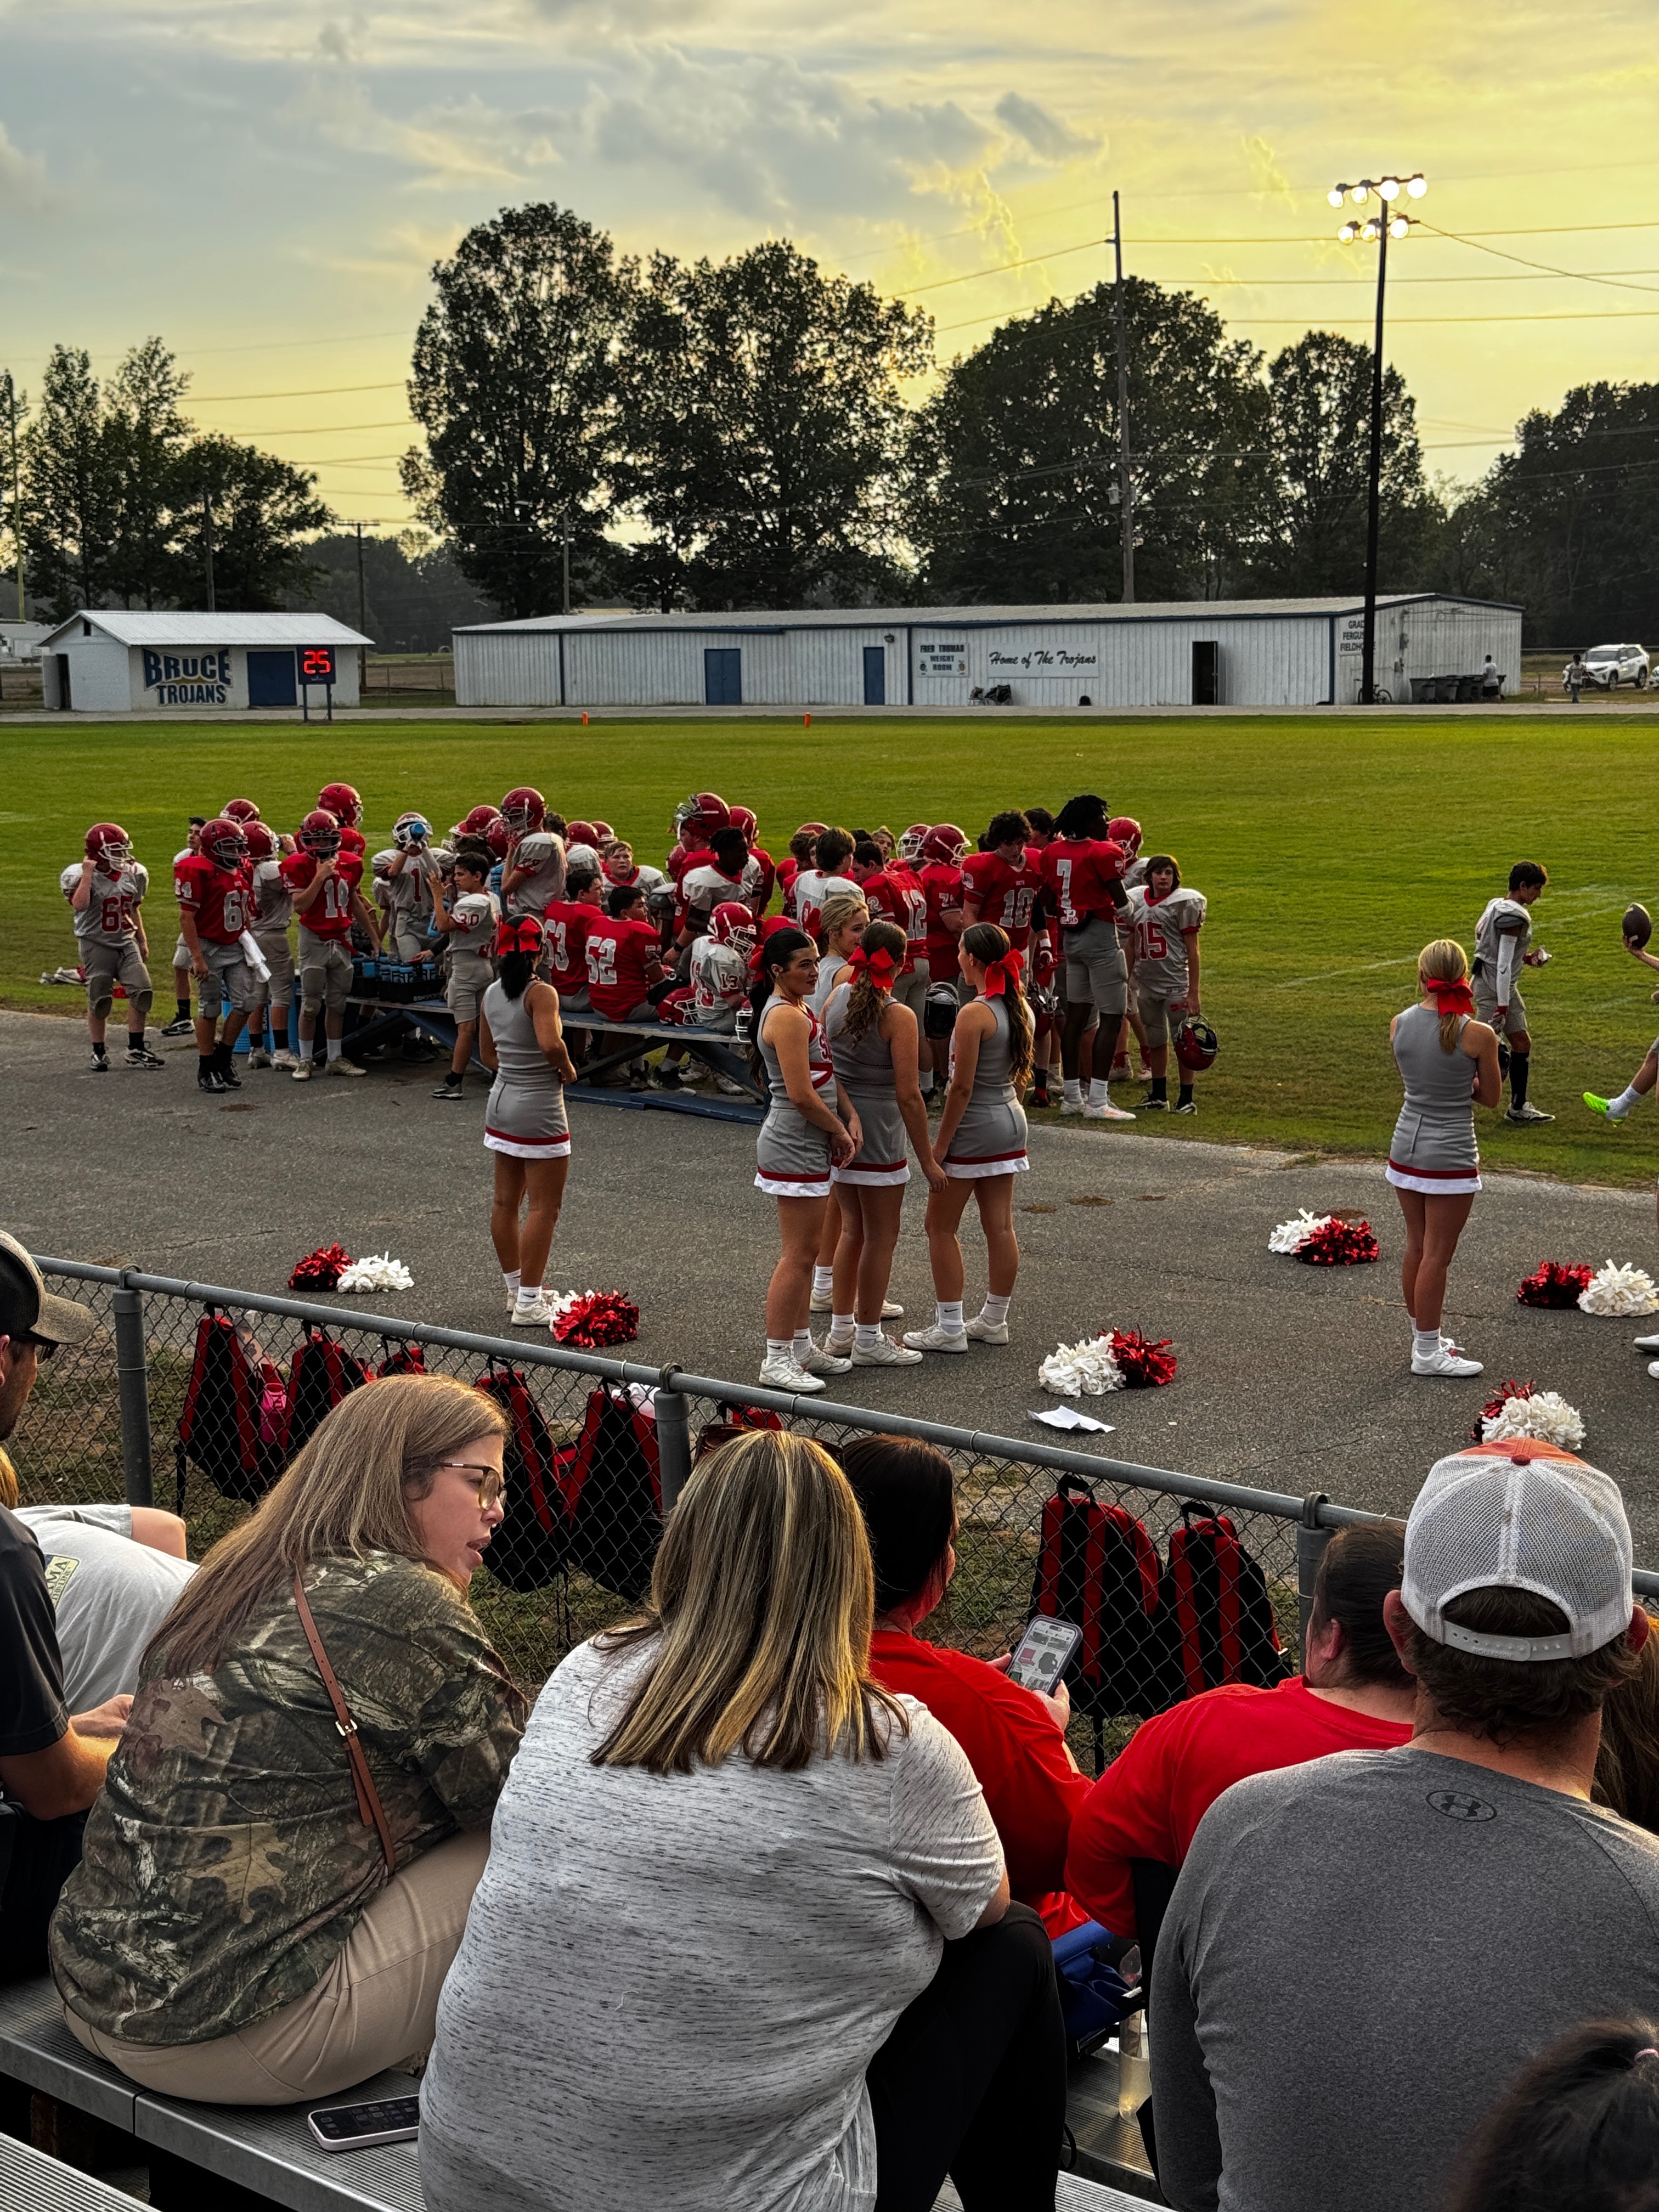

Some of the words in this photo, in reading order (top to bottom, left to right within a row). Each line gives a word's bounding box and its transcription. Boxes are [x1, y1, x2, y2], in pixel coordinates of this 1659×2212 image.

[142, 648, 231, 689] BRUCE
[303, 650, 331, 674] 25
[989, 651, 1019, 665] Home
[1021, 652, 1032, 669] of
[1034, 651, 1053, 665] The
[1056, 651, 1097, 668] Trojans
[157, 685, 226, 704] TROJANS
[411, 867, 421, 903] 1
[1057, 859, 1072, 909] 7
[101, 896, 134, 933] 65
[459, 913, 480, 928] 30
[902, 889, 928, 941] 12
[999, 888, 1035, 928] 10
[585, 935, 617, 985] 52
[1136, 922, 1169, 961] 15
[720, 973, 739, 990] 13
